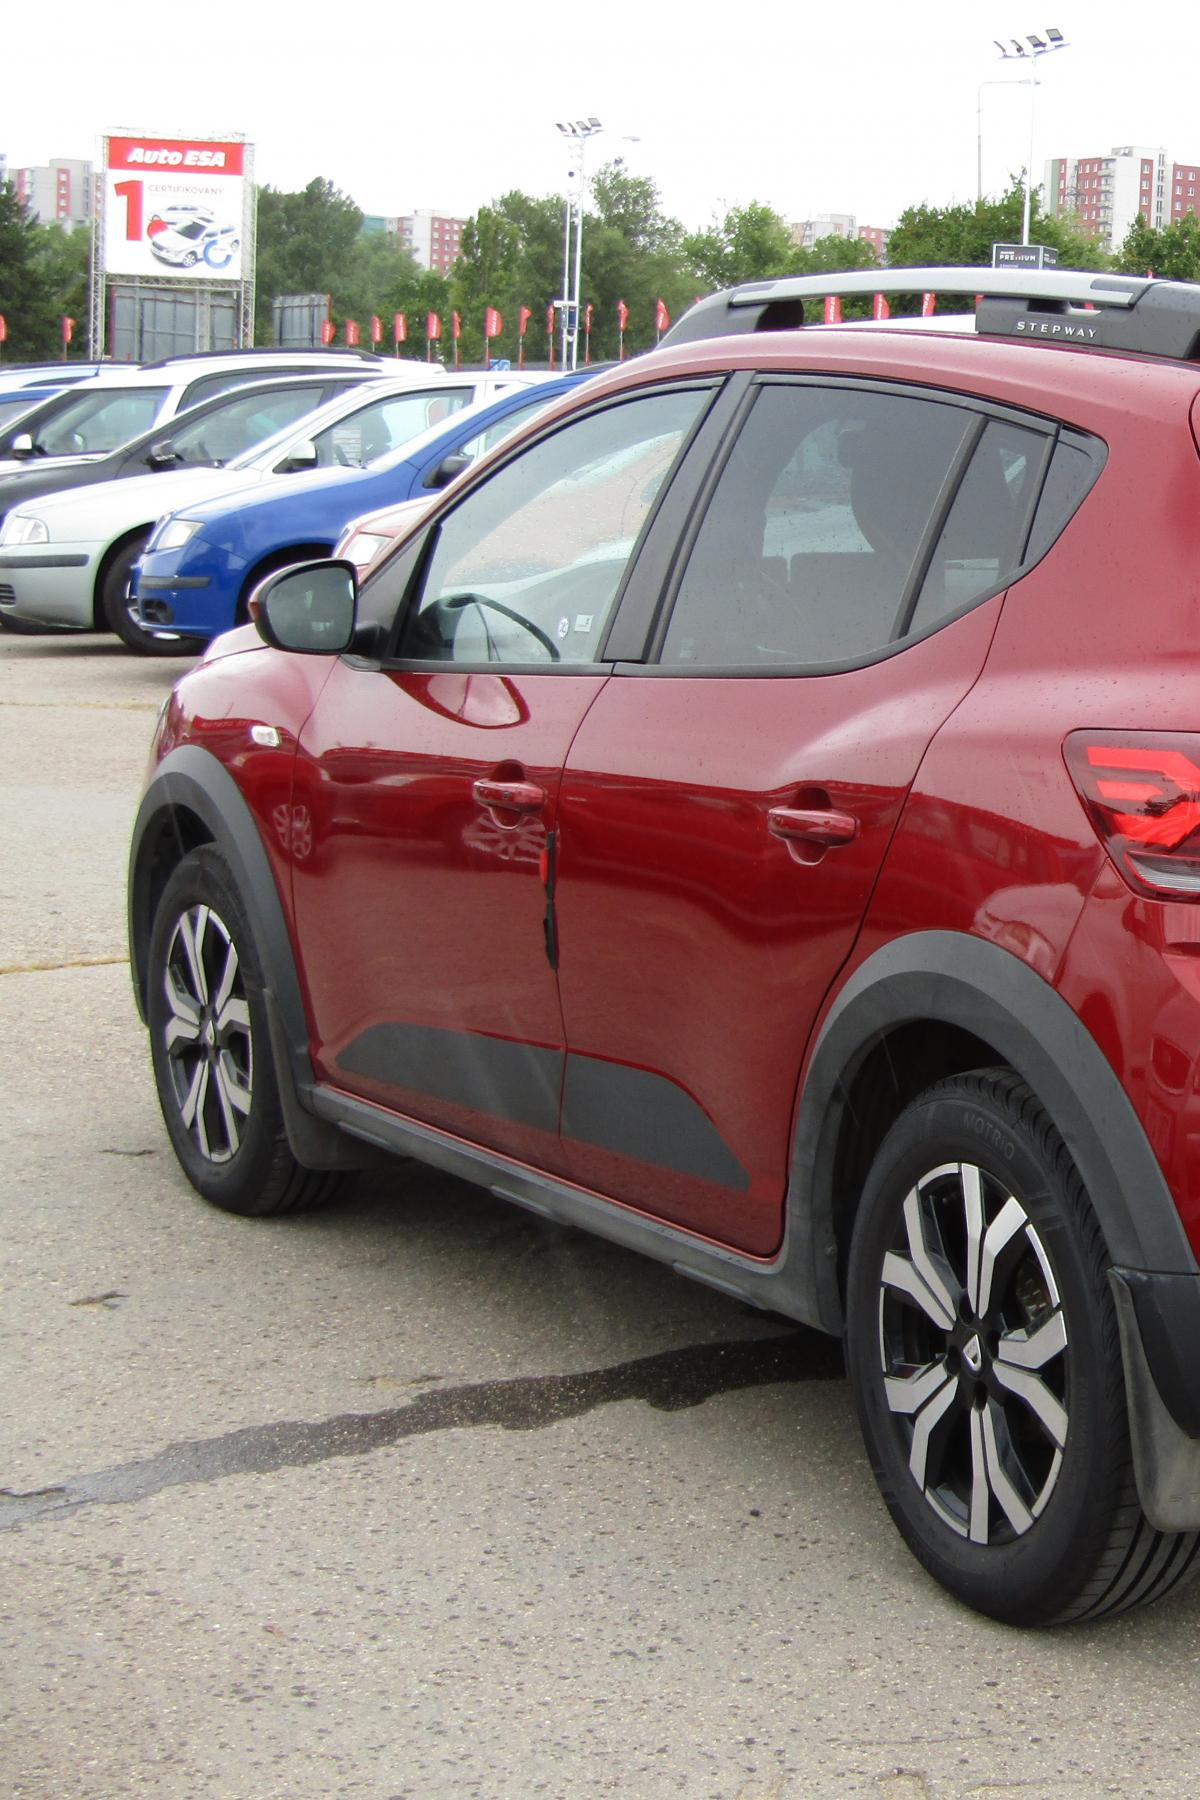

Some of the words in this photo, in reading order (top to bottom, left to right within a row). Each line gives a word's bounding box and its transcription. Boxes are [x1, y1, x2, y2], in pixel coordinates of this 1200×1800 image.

[127, 147, 183, 166] Auto
[183, 150, 226, 168] ESA
[1016, 321, 1097, 338] STEPWAY
